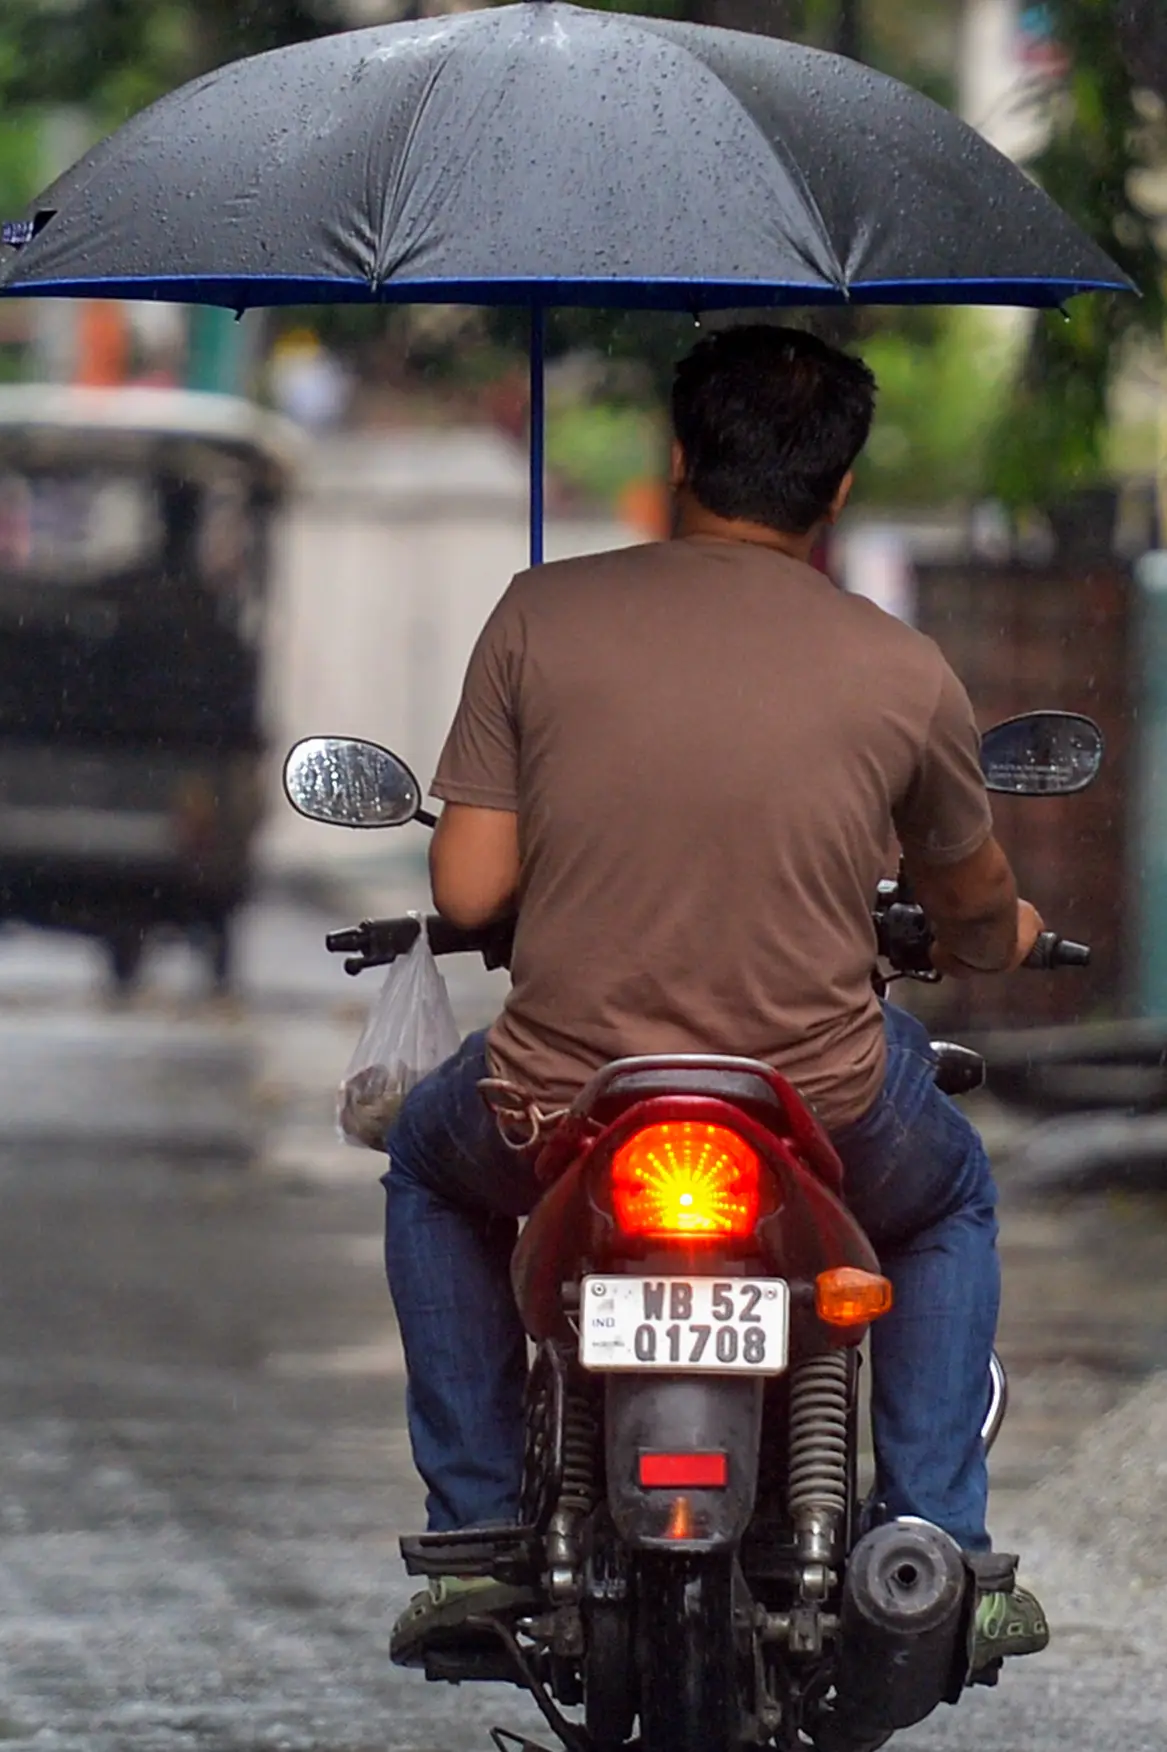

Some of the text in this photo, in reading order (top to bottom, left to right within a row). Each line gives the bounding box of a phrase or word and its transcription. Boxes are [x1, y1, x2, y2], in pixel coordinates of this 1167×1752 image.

[643, 1282, 762, 1323] WB 52
[592, 1318, 615, 1328] IND
[635, 1324, 766, 1364] Q1708
